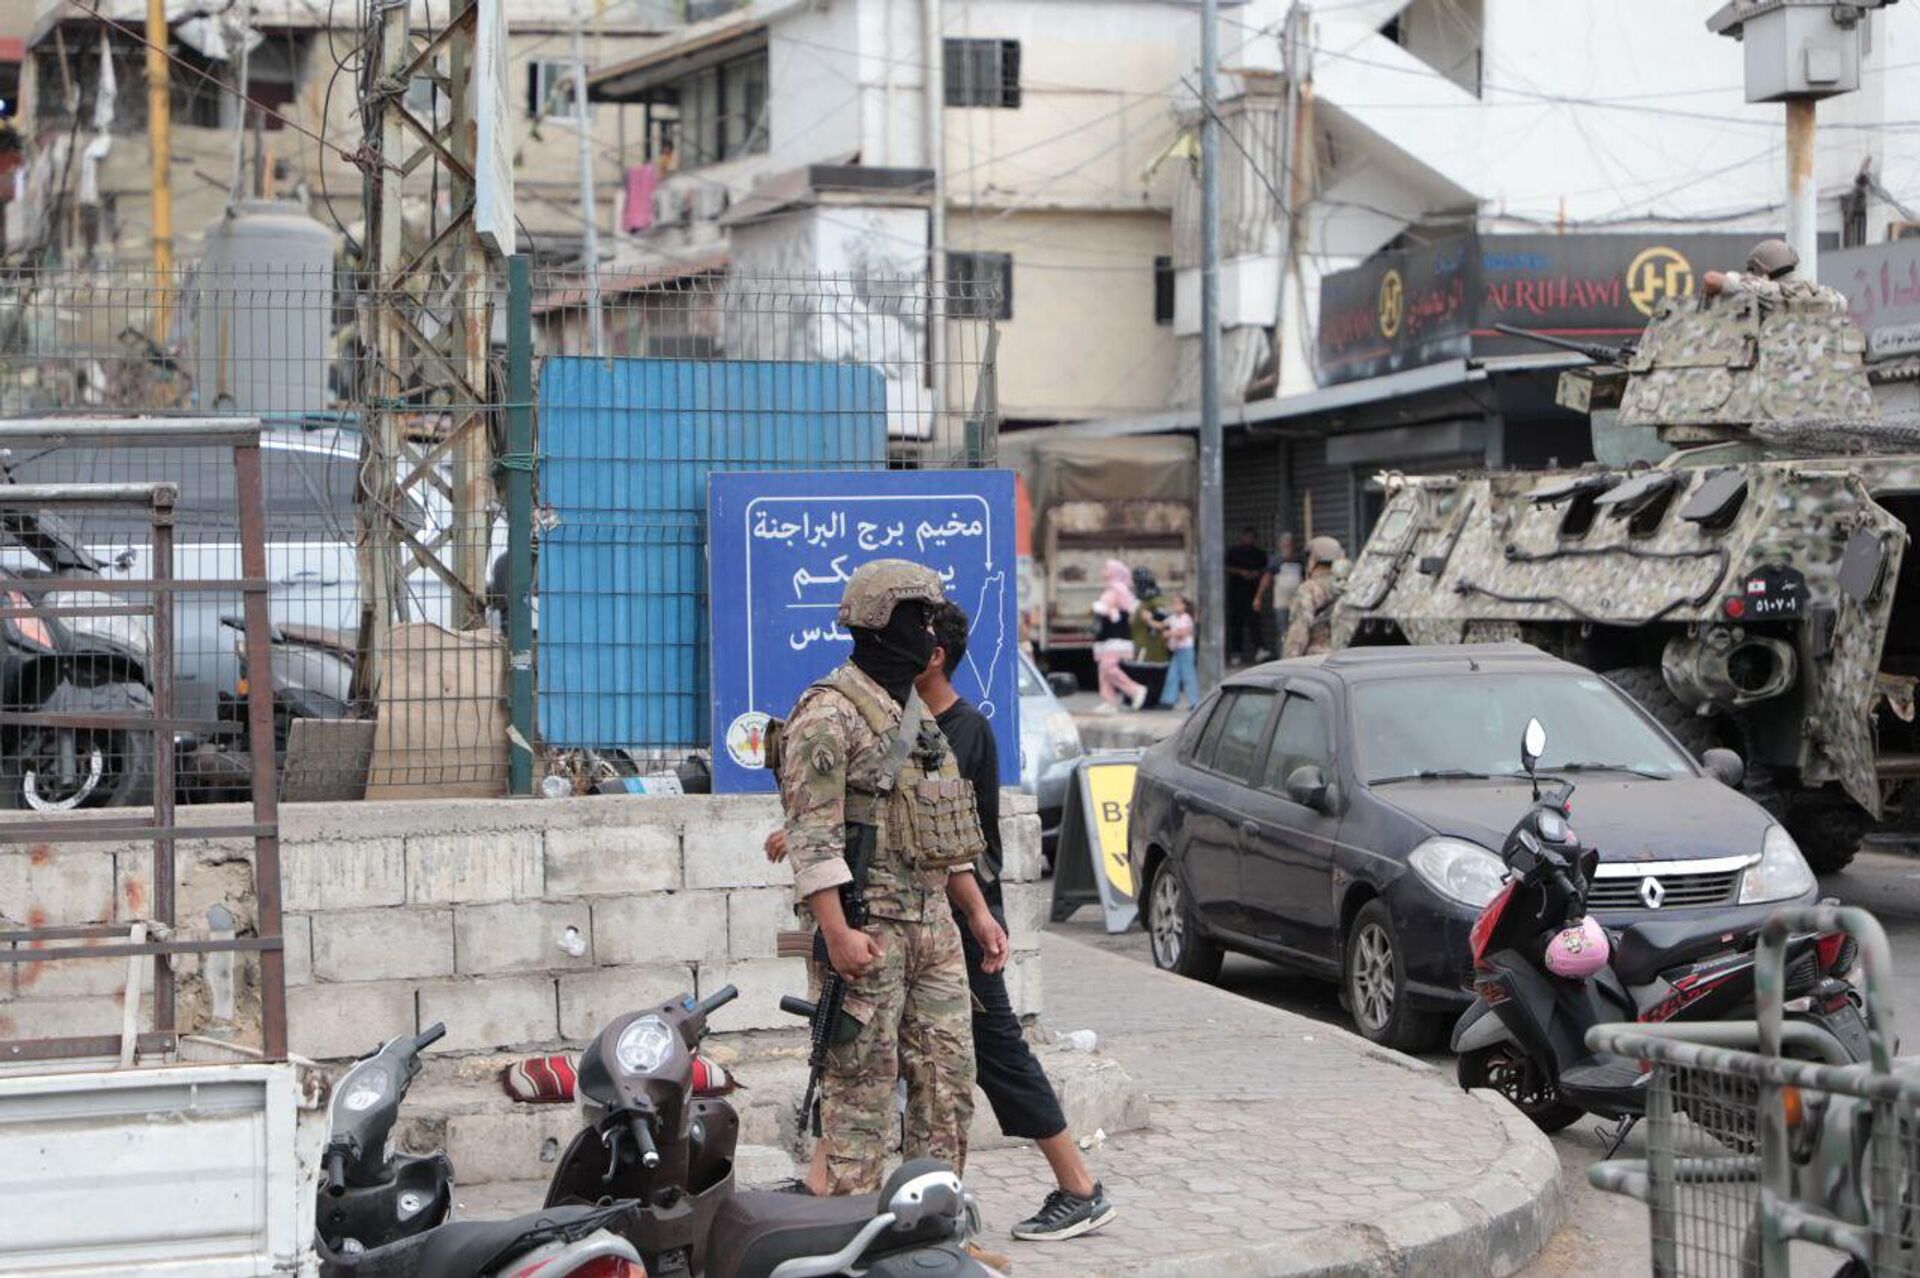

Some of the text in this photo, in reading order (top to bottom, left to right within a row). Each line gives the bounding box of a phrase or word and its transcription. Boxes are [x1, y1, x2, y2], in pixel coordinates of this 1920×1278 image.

[753, 510, 984, 553] مخيم برج البراجنة
